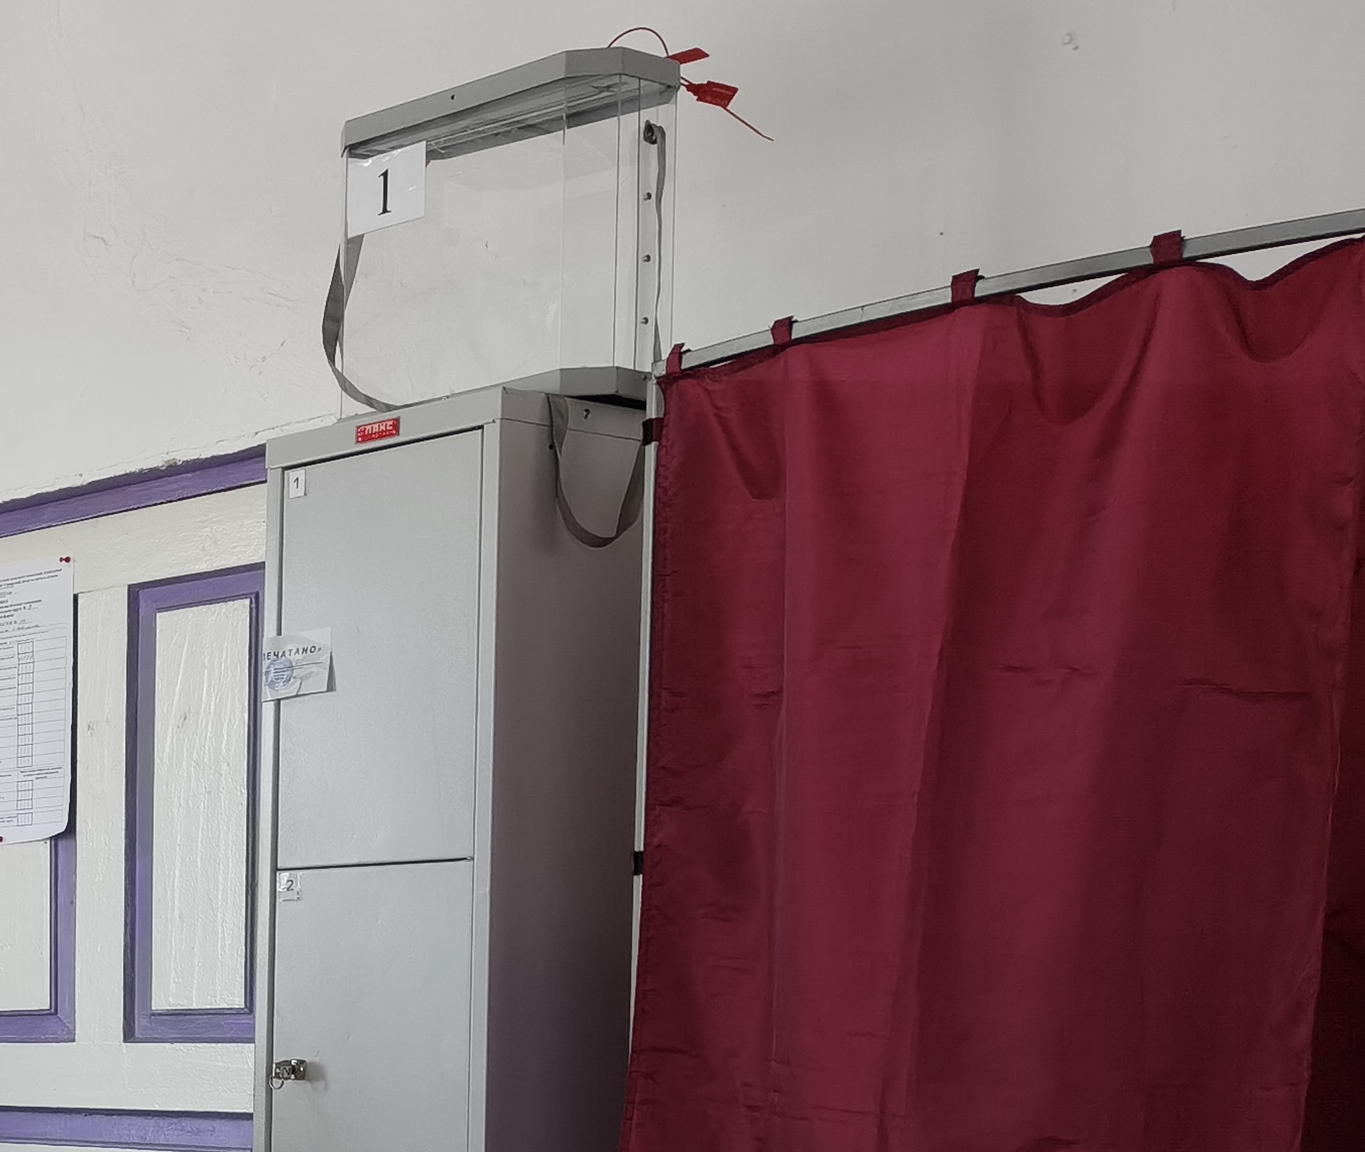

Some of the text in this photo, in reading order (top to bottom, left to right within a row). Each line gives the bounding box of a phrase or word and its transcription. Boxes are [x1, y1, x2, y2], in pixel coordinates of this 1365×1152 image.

[377, 168, 392, 216] 1
[293, 476, 299, 489] 1
[286, 879, 294, 891] 2
